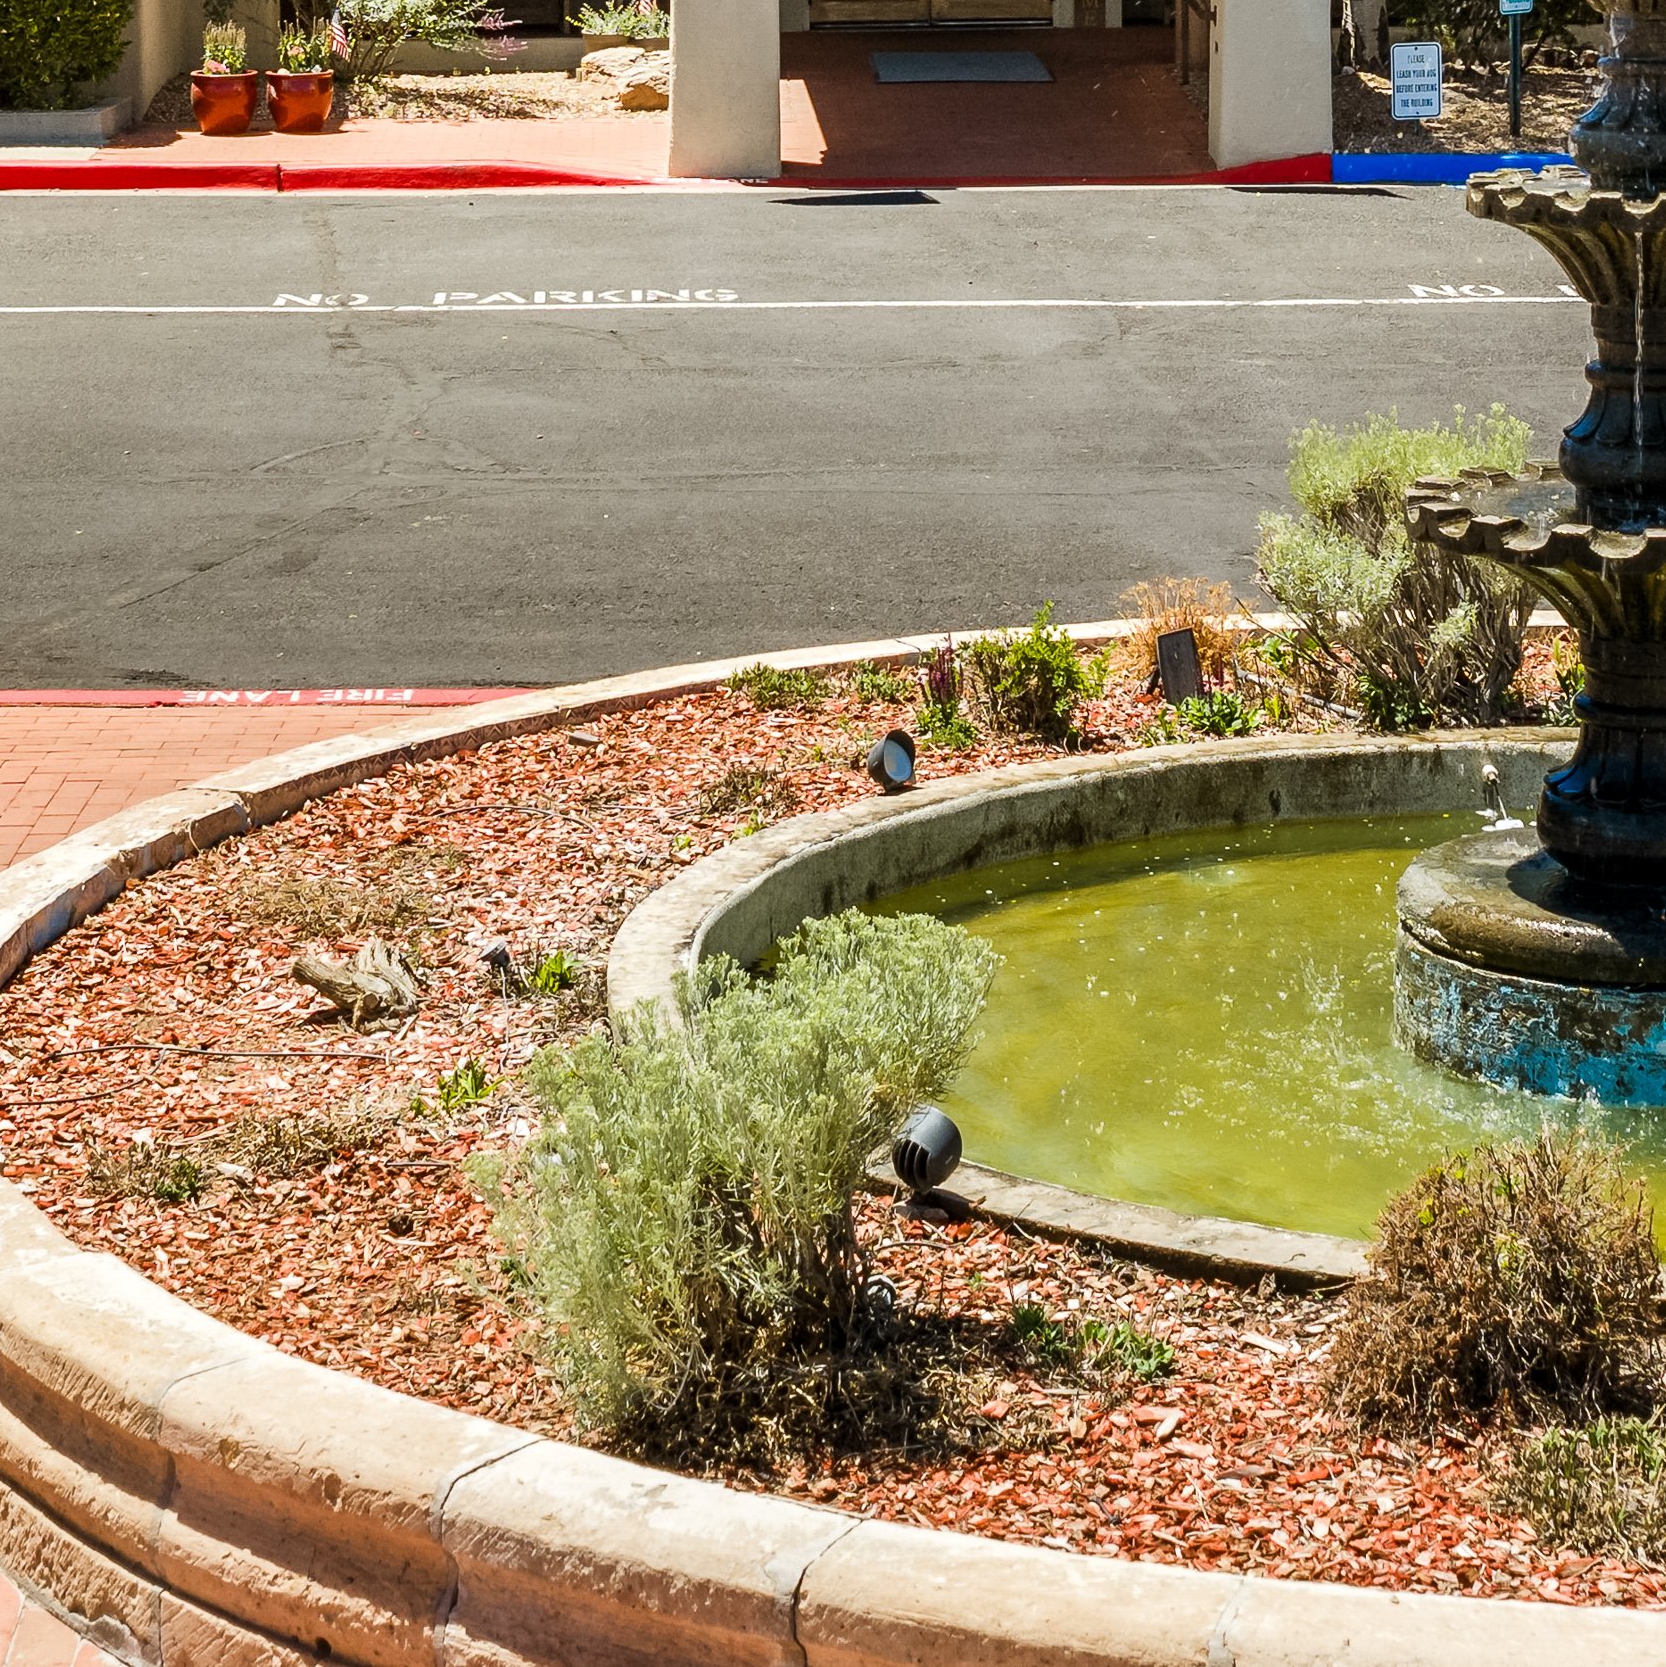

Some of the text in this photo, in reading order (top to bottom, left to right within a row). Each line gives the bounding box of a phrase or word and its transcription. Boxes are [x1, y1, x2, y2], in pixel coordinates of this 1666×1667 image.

[1407, 54, 1425, 63] PLEASE
[1396, 69, 1436, 78] LEASH YOUR DOG
[1396, 83, 1437, 93] BEFORE ENTERING
[1401, 98, 1433, 107] THE BUILDING
[1406, 284, 1505, 297] NO
[272, 288, 740, 306] NO PARKING
[179, 689, 414, 702] FIRE LANE
